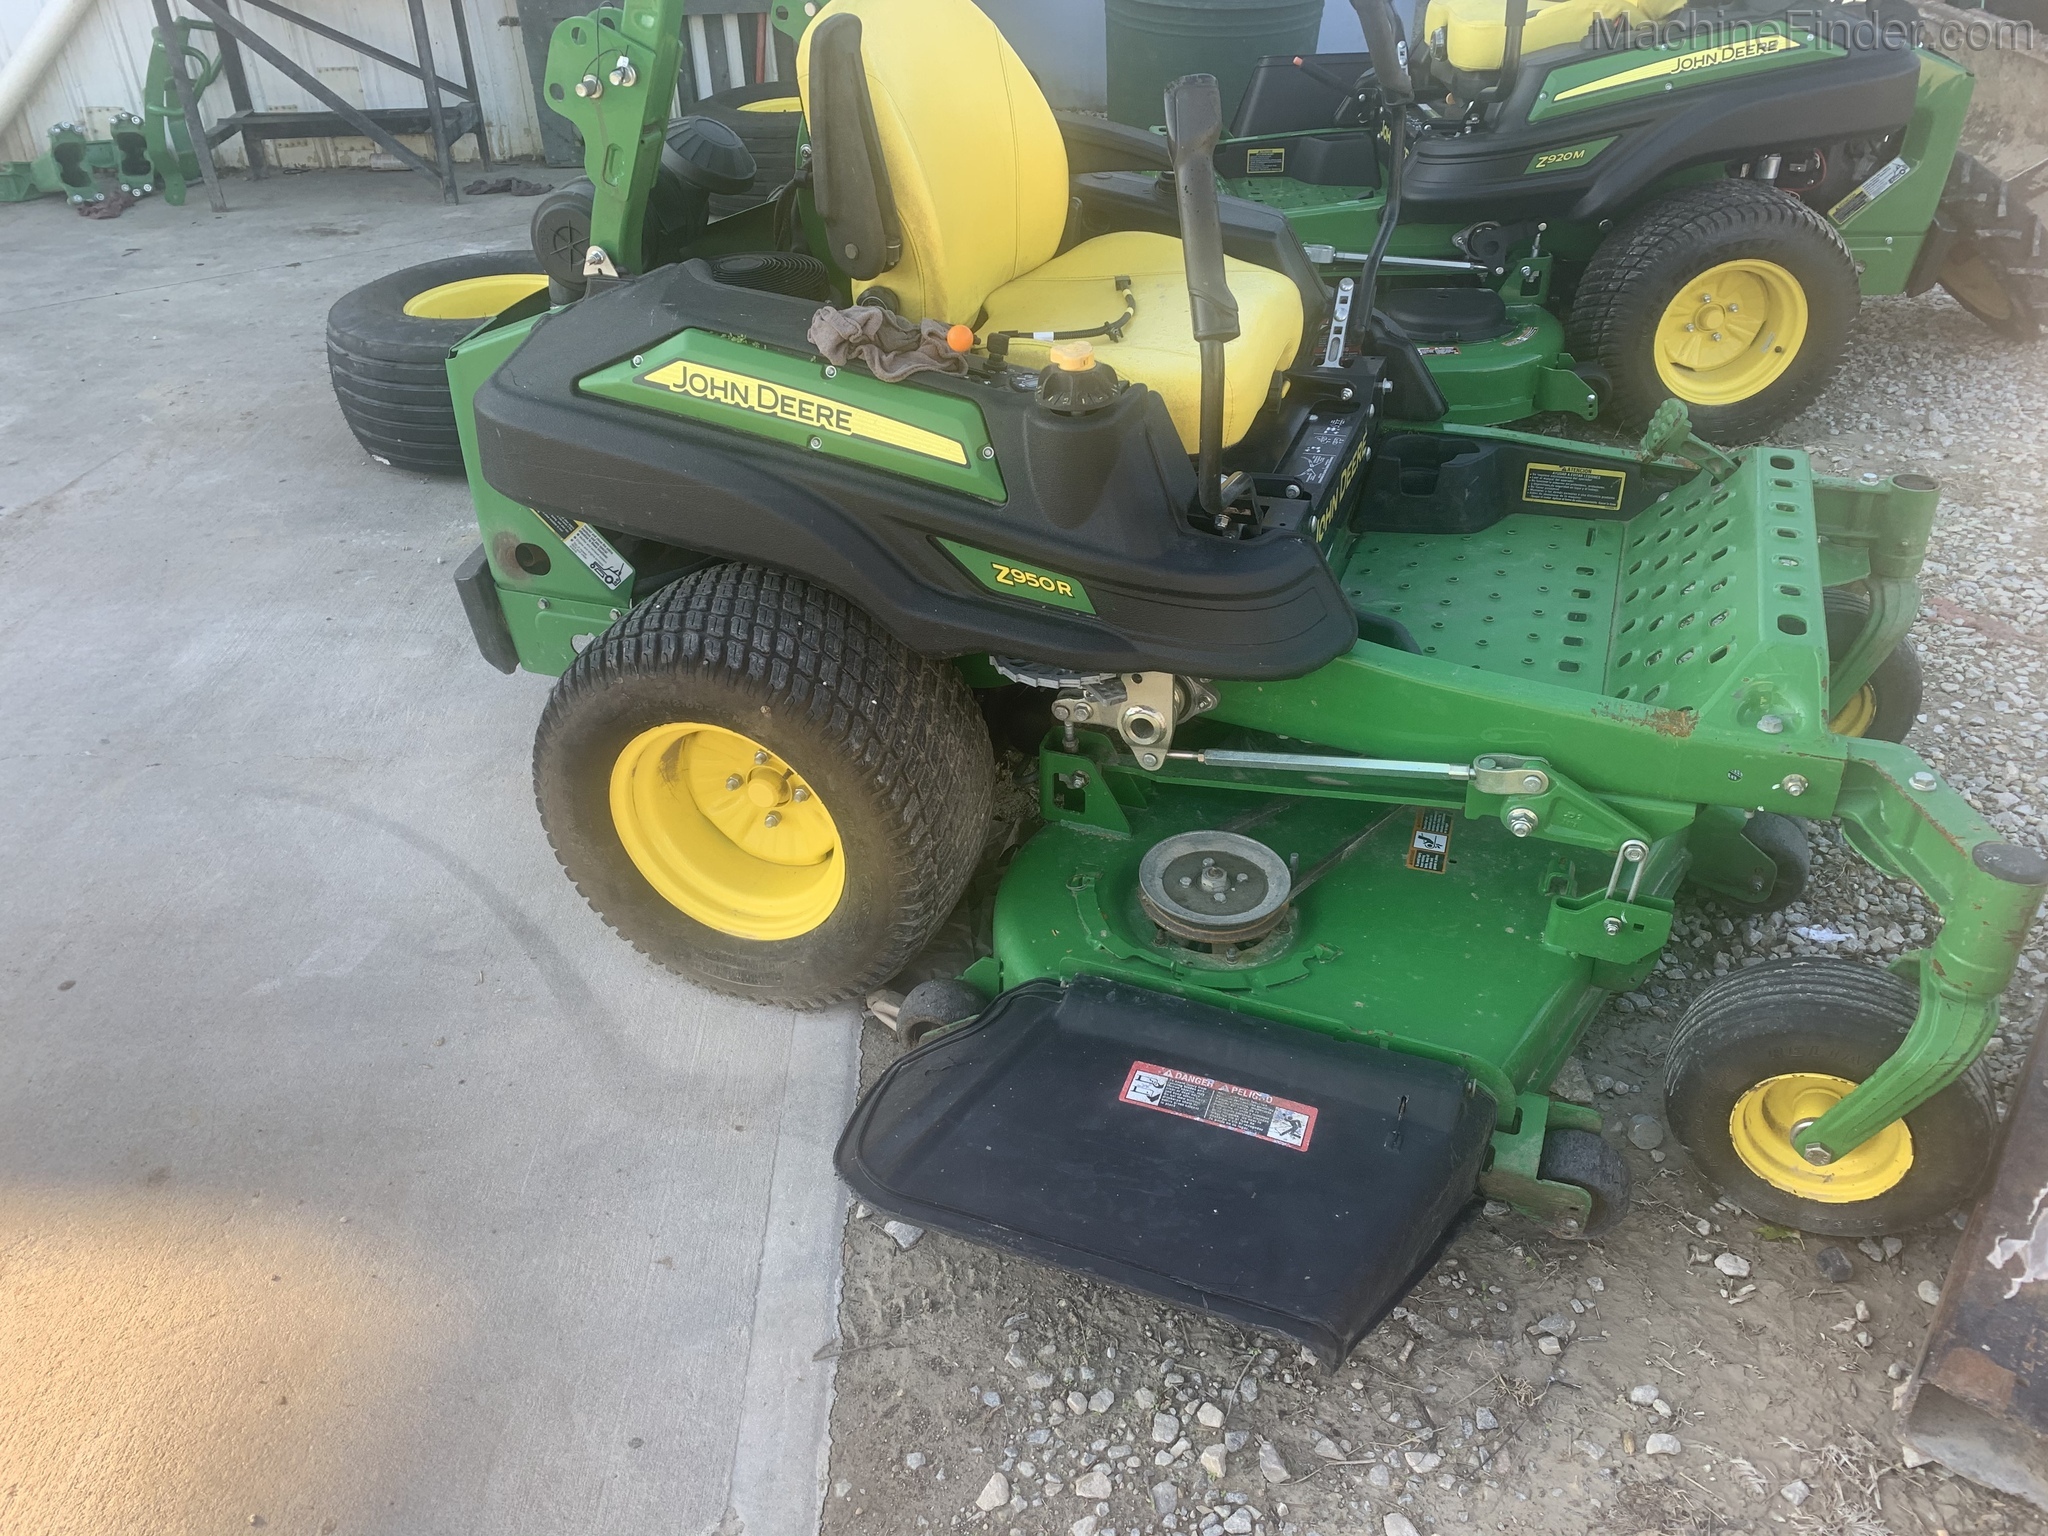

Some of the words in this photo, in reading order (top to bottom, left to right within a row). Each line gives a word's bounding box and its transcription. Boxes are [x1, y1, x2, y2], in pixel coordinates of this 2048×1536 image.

[1671, 52, 1717, 73] JOHN
[1722, 40, 1779, 61] DEERE
[1535, 149, 1586, 169] Z920M
[672, 365, 749, 405] JOHN
[757, 383, 853, 432] DEERE
[991, 562, 1075, 598] Z950R
[1231, 1086, 1273, 1104] PELIGO
